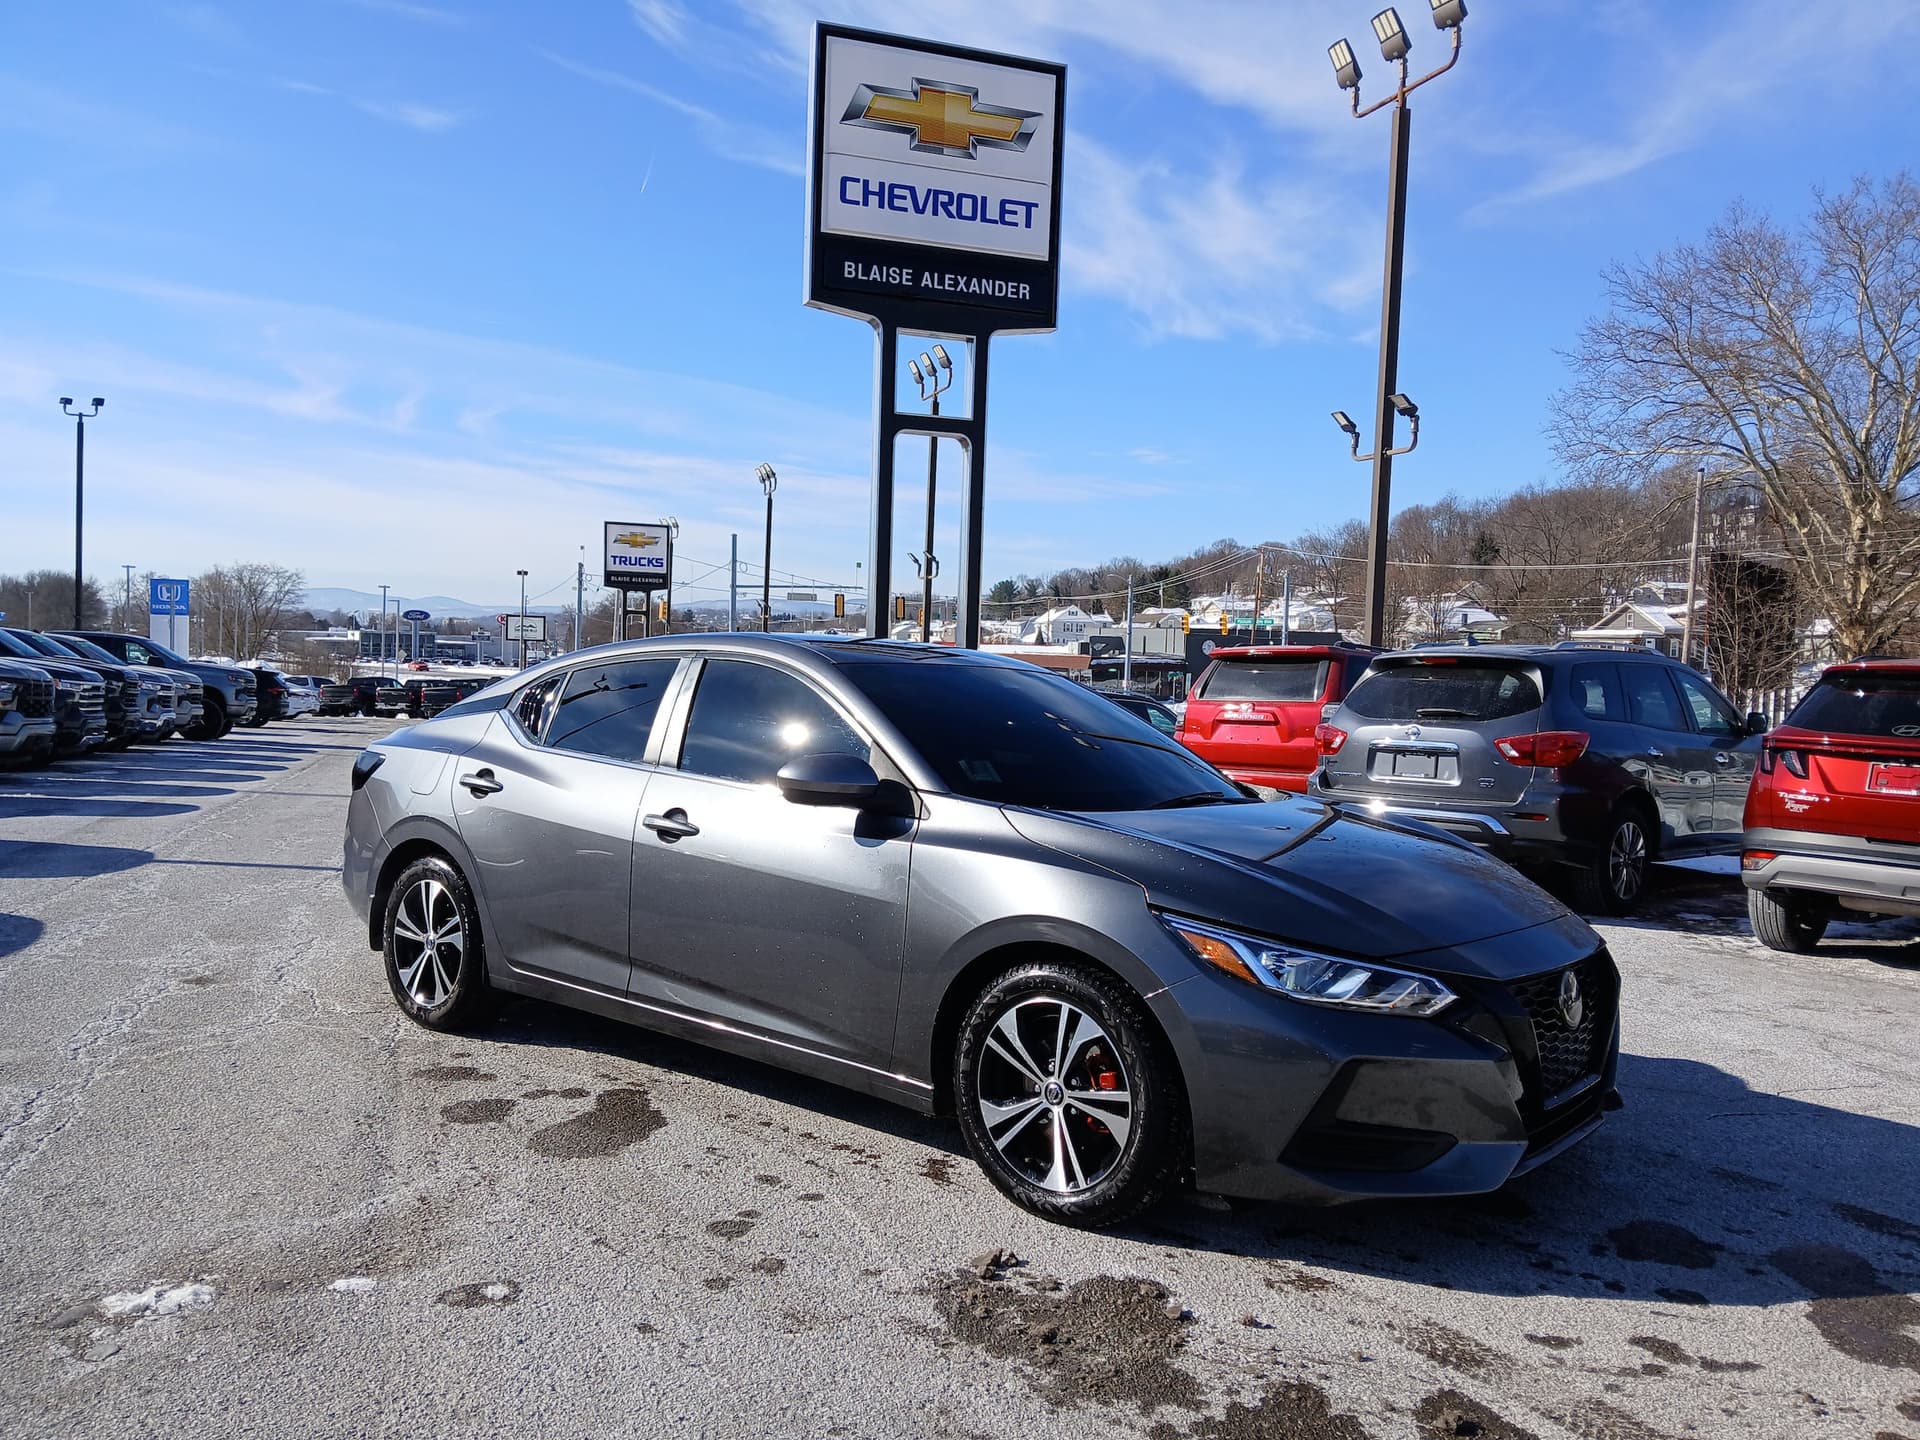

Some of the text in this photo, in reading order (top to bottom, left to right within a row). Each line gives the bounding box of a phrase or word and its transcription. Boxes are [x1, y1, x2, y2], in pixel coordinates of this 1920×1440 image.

[839, 175, 1040, 229] CHEVROLET
[843, 261, 1031, 300] BLAISE ALEXANDER
[610, 554, 664, 568] TRUCKS
